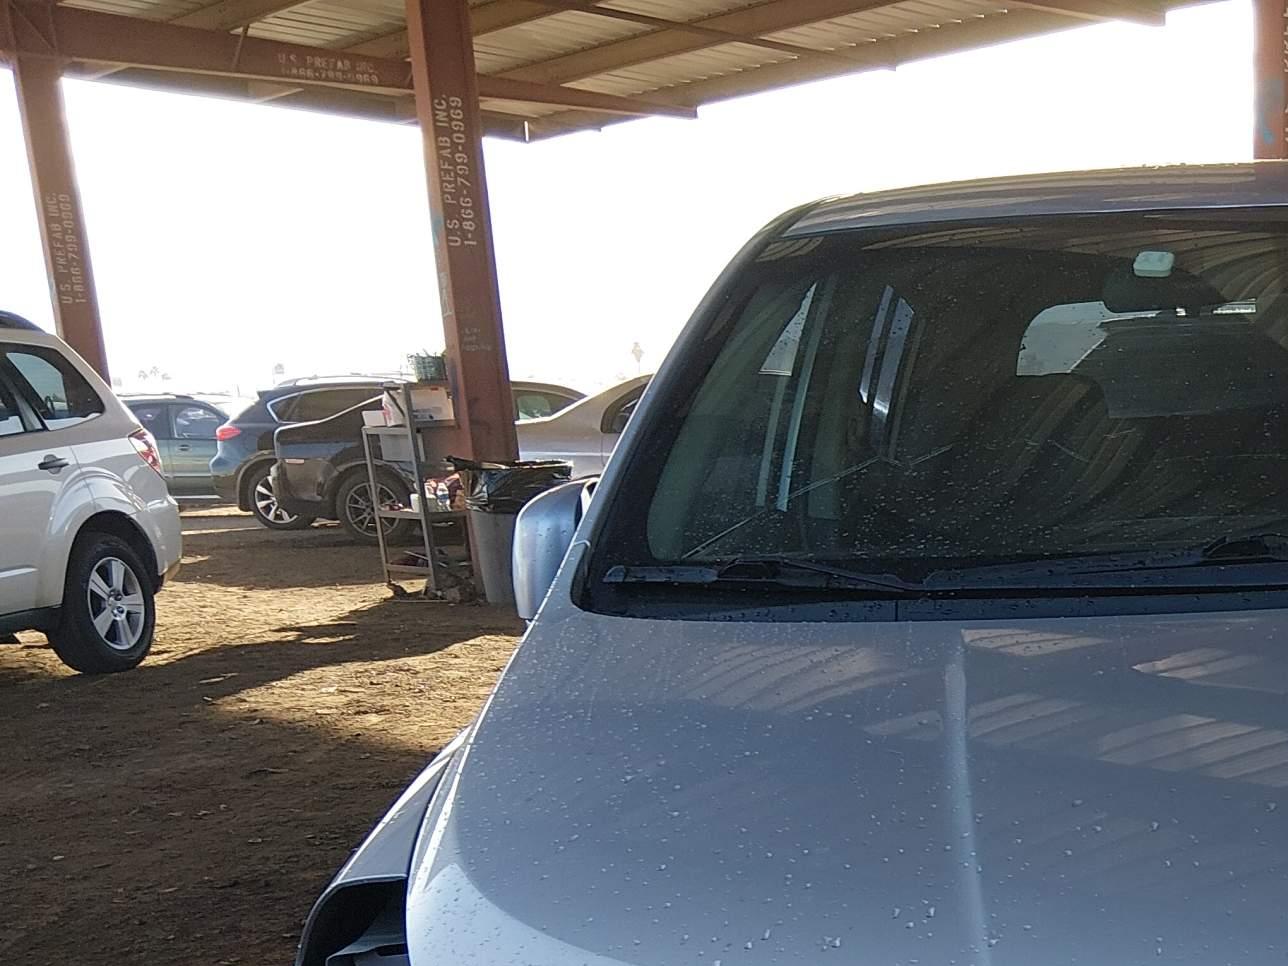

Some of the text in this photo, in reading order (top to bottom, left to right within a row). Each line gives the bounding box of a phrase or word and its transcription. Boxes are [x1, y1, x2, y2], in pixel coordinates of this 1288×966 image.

[437, 135, 457, 204] PREFAB
[449, 96, 477, 246] 1-866-799-0969
[49, 223, 69, 273] PREFAB
[447, 215, 462, 246] U.S.
